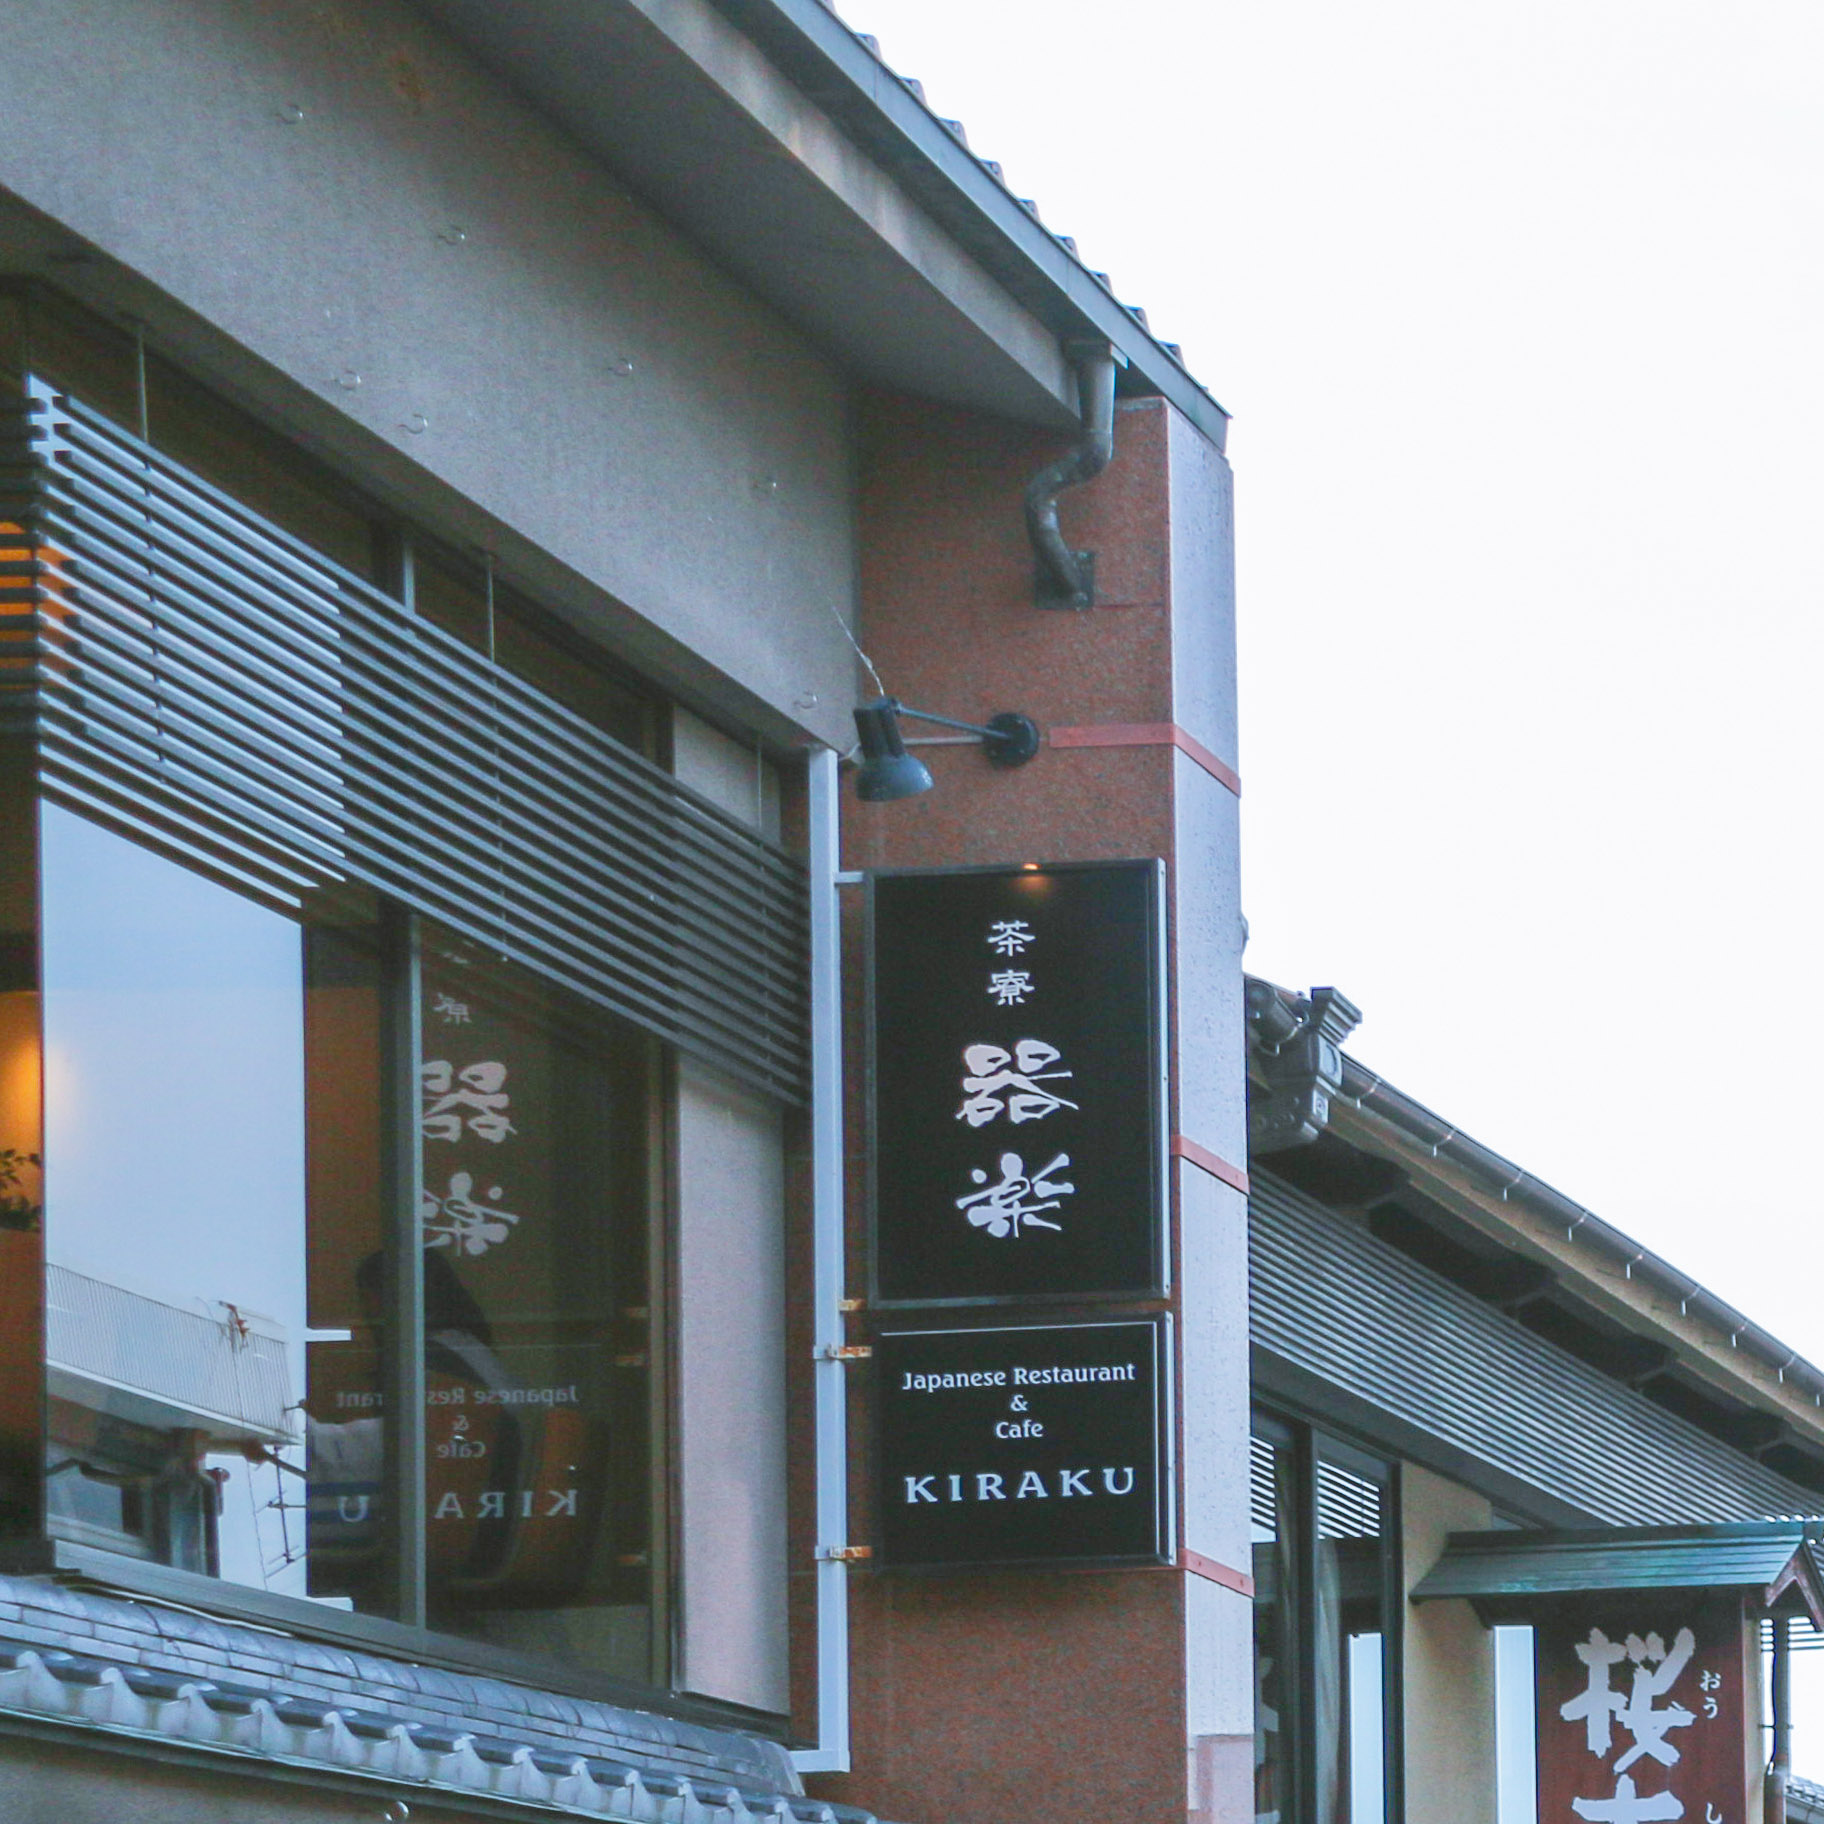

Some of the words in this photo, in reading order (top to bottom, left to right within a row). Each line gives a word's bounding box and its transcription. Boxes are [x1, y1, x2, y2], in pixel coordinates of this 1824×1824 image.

[987, 919, 1036, 1007] 茶寮
[955, 1038, 1079, 1240] 器楽
[902, 1371, 1006, 1393] Japanese
[1013, 1363, 1136, 1386] Restaurant
[1009, 1394, 1029, 1412] &
[994, 1419, 1044, 1439] Cafe
[904, 1467, 1134, 1504] KIRAKU
